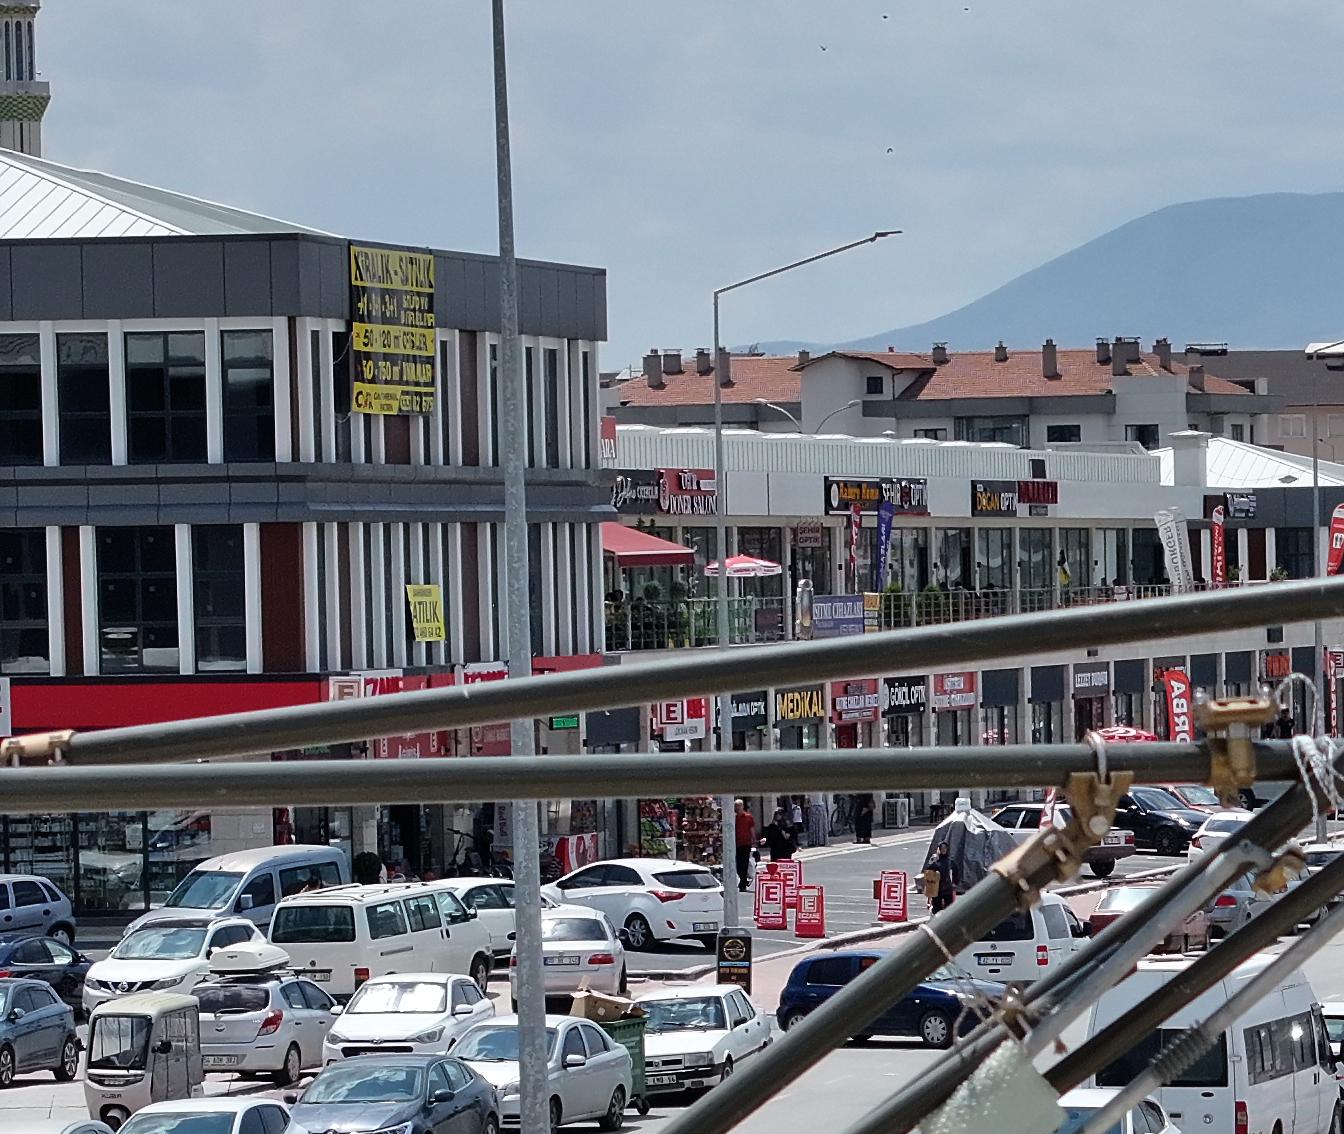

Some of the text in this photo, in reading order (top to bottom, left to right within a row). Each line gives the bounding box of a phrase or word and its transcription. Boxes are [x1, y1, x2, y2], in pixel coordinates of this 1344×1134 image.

[665, 703, 679, 720] E
[777, 691, 825, 720] MEDİKAL
[765, 886, 779, 900] E
[886, 885, 899, 899] E
[805, 898, 816, 910] E
